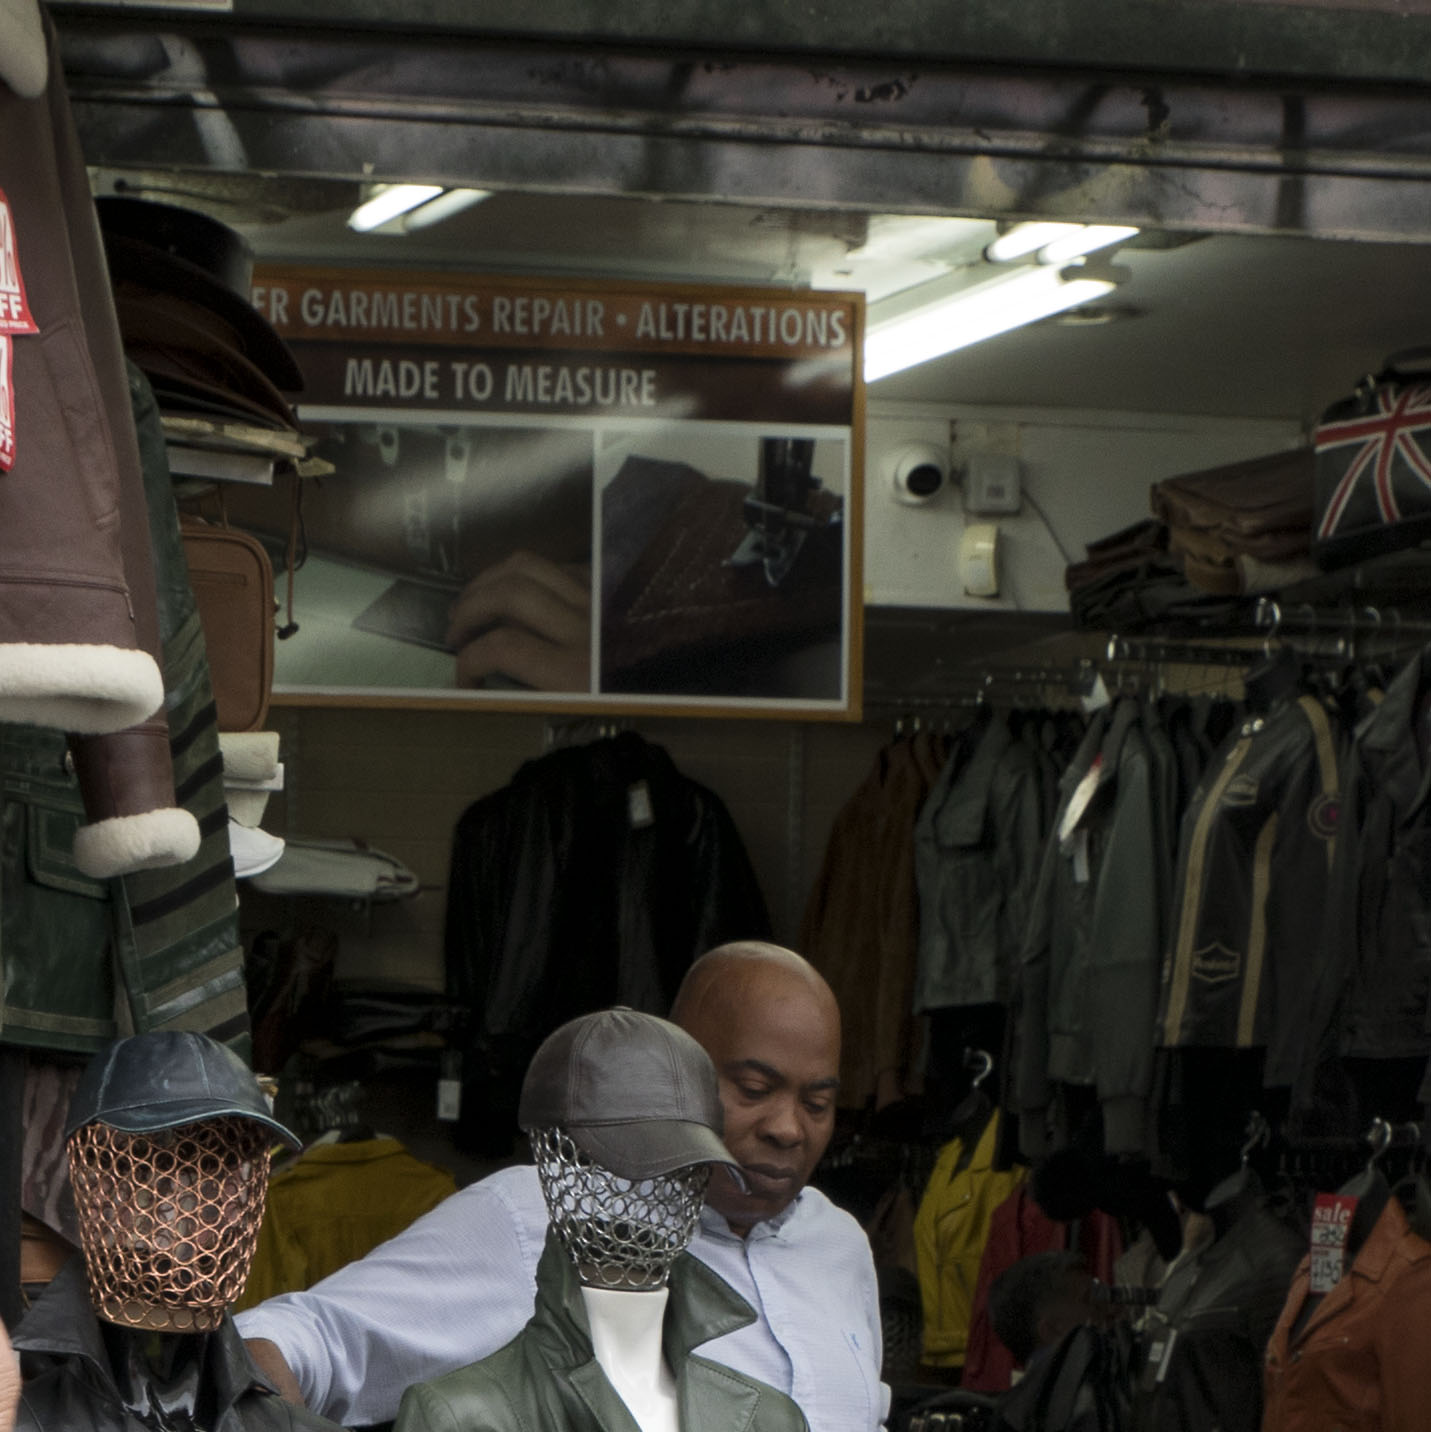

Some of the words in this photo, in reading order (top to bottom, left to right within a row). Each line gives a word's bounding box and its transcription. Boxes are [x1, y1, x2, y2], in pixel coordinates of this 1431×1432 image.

[252, 286, 288, 325] ER
[301, 288, 479, 332] GARMENTS
[493, 295, 605, 337] REPAIR
[636, 302, 846, 348] ALTERATIONS
[344, 358, 440, 399] MADE
[452, 362, 493, 400] TO
[505, 364, 656, 406] MEASURE
[1314, 1201, 1352, 1223] sale
